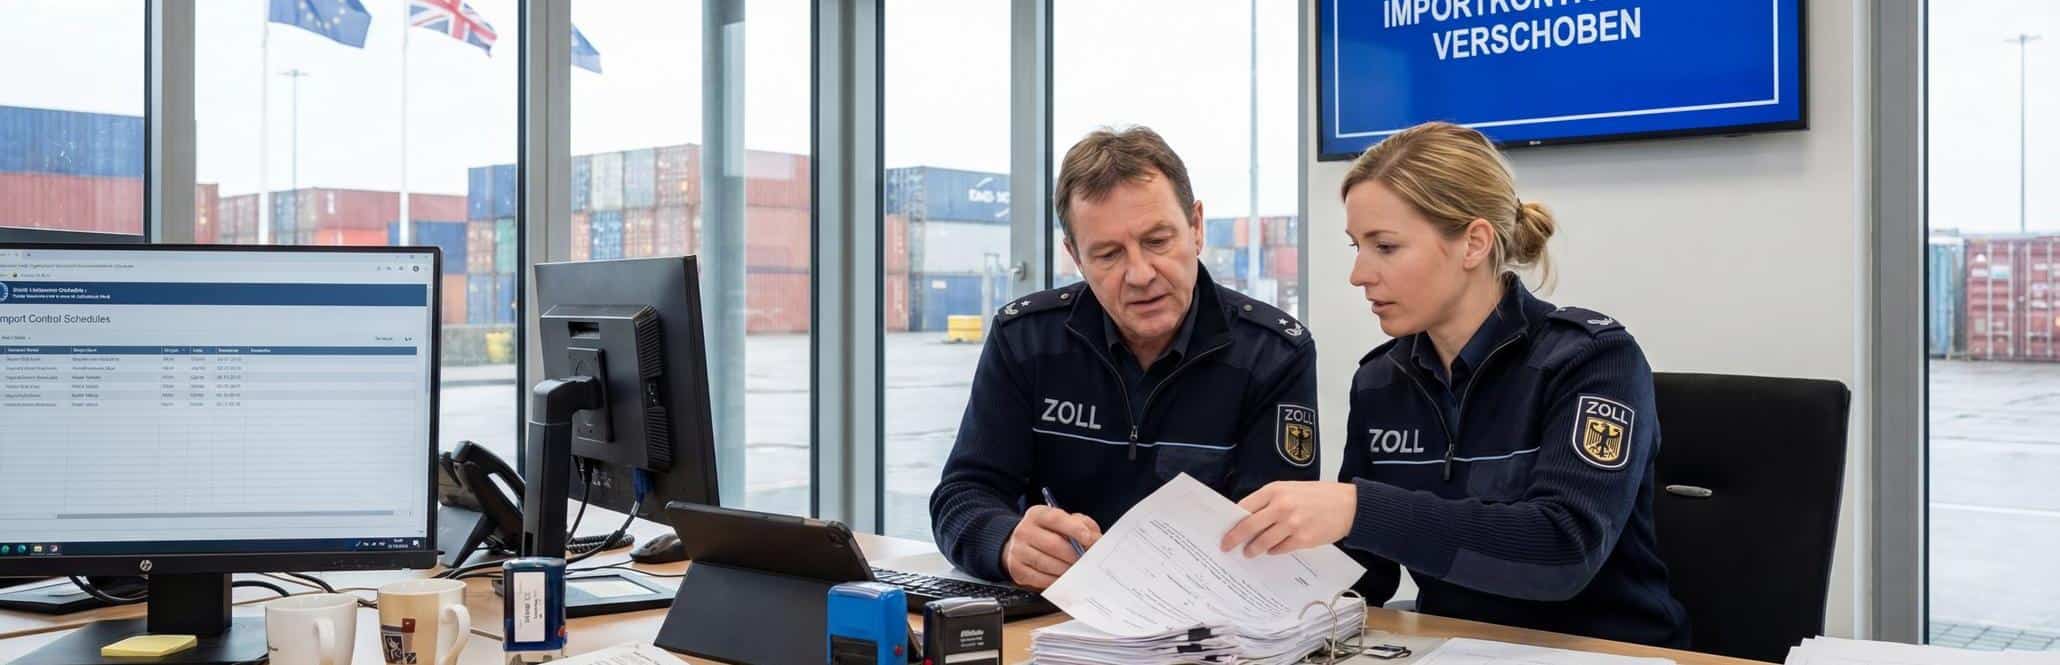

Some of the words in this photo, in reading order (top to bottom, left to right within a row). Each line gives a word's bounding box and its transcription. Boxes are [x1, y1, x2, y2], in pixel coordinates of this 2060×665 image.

[1432, 7, 1641, 60] VERSCHOBEN
[0, 314, 26, 326] mport
[28, 313, 61, 324] Control
[63, 313, 112, 324] Schedules
[1041, 398, 1102, 430] ZOLL
[1284, 408, 1313, 425] ZOLL
[1585, 401, 1628, 425] ZOLL
[1368, 428, 1425, 453] ZOLL
